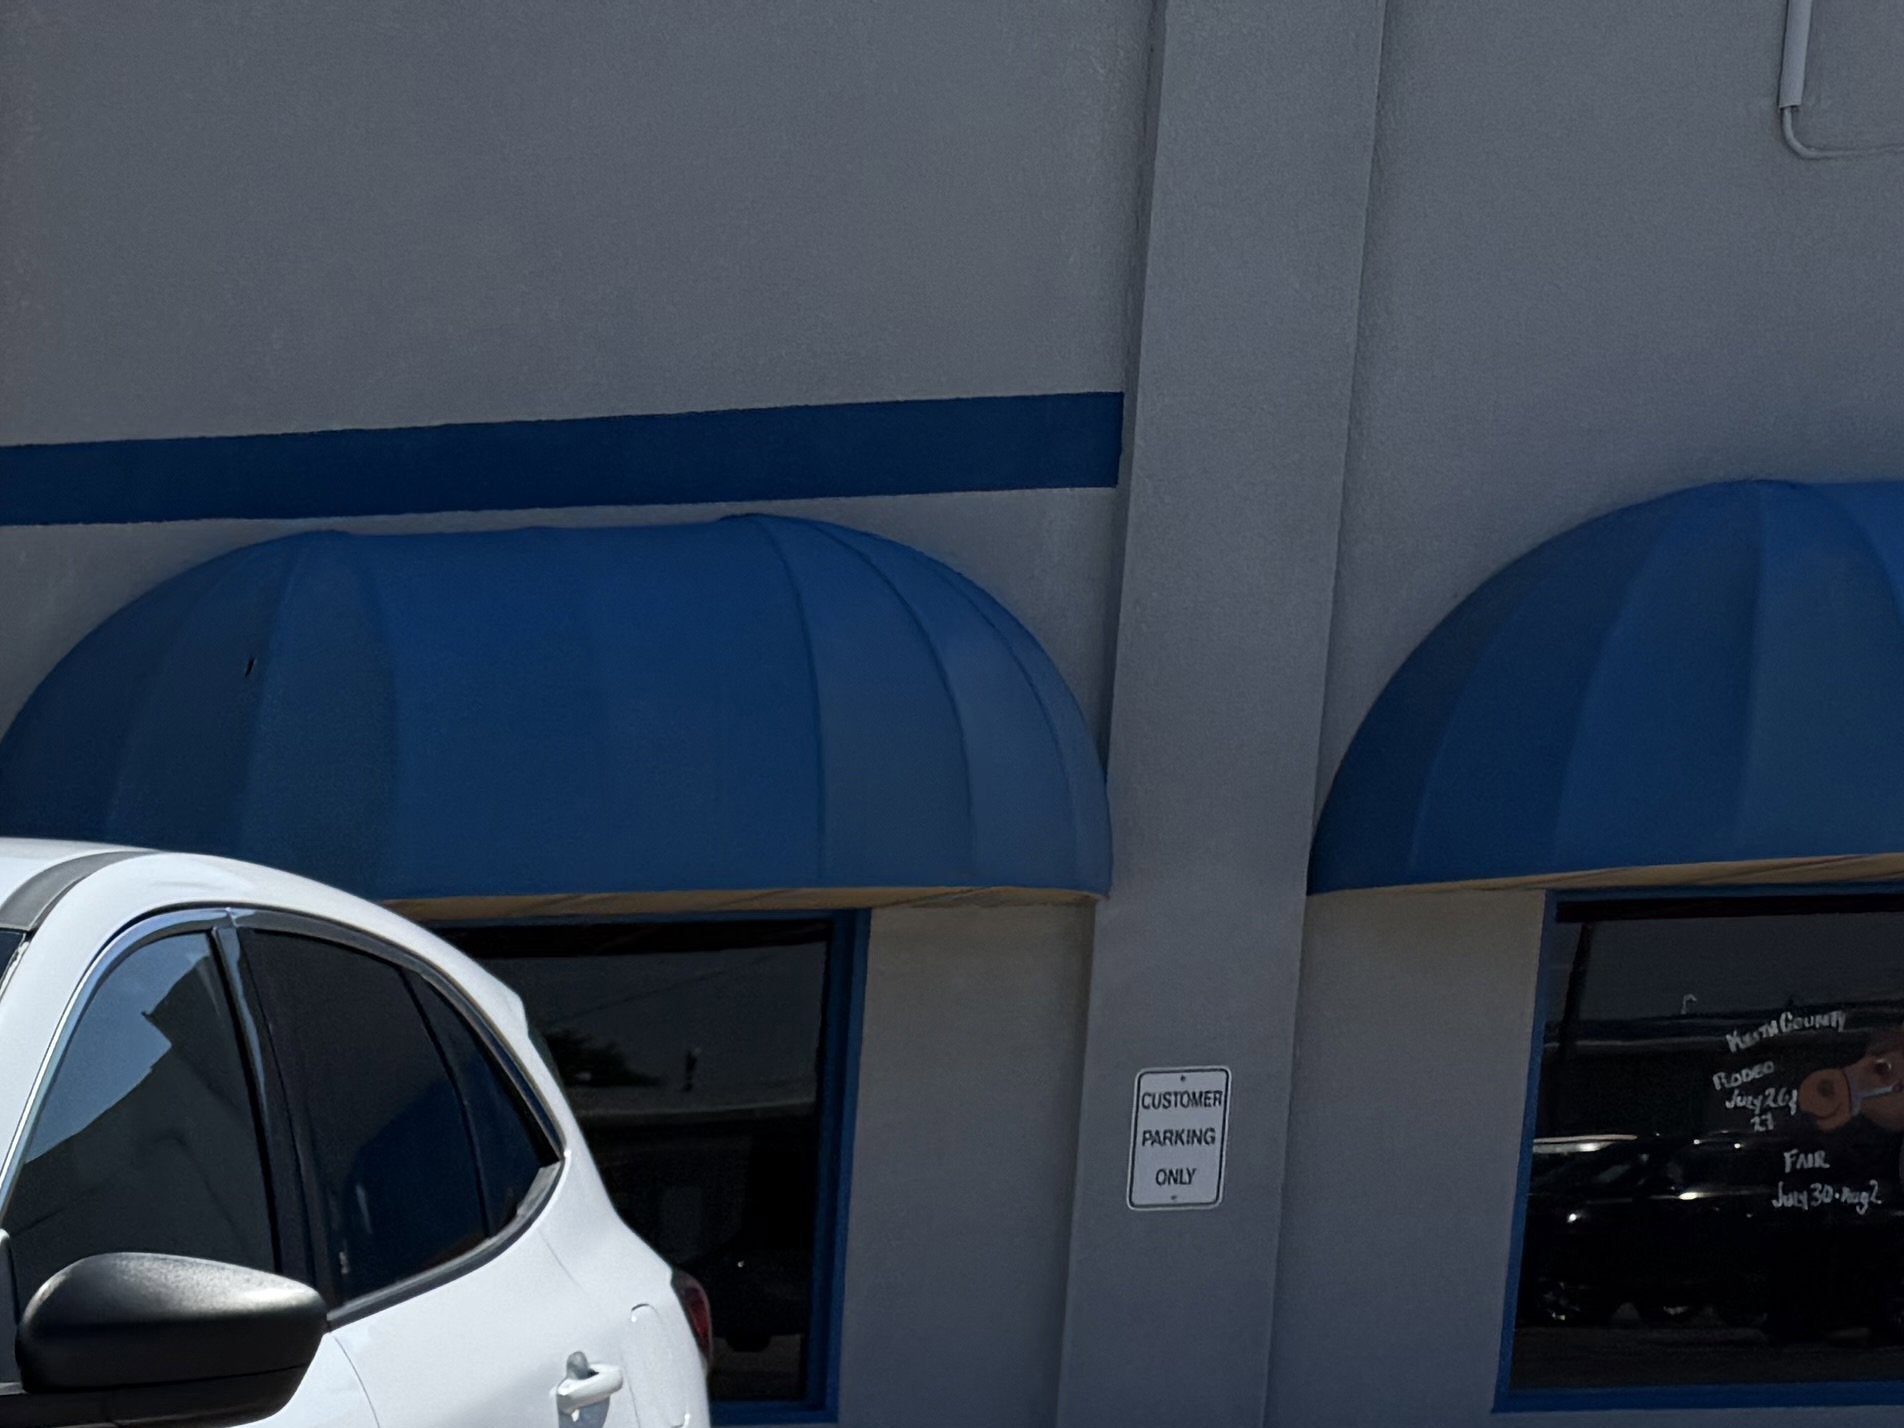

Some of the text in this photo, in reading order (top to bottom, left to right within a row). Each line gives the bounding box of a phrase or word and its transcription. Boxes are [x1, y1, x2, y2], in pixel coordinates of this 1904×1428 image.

[1141, 1089, 1223, 1110] CUSTOMER
[1142, 1127, 1216, 1147] PARKING
[1783, 1148, 1830, 1173] FAIR
[1155, 1167, 1197, 1187] ONLY
[1810, 1182, 1833, 1206] 30
